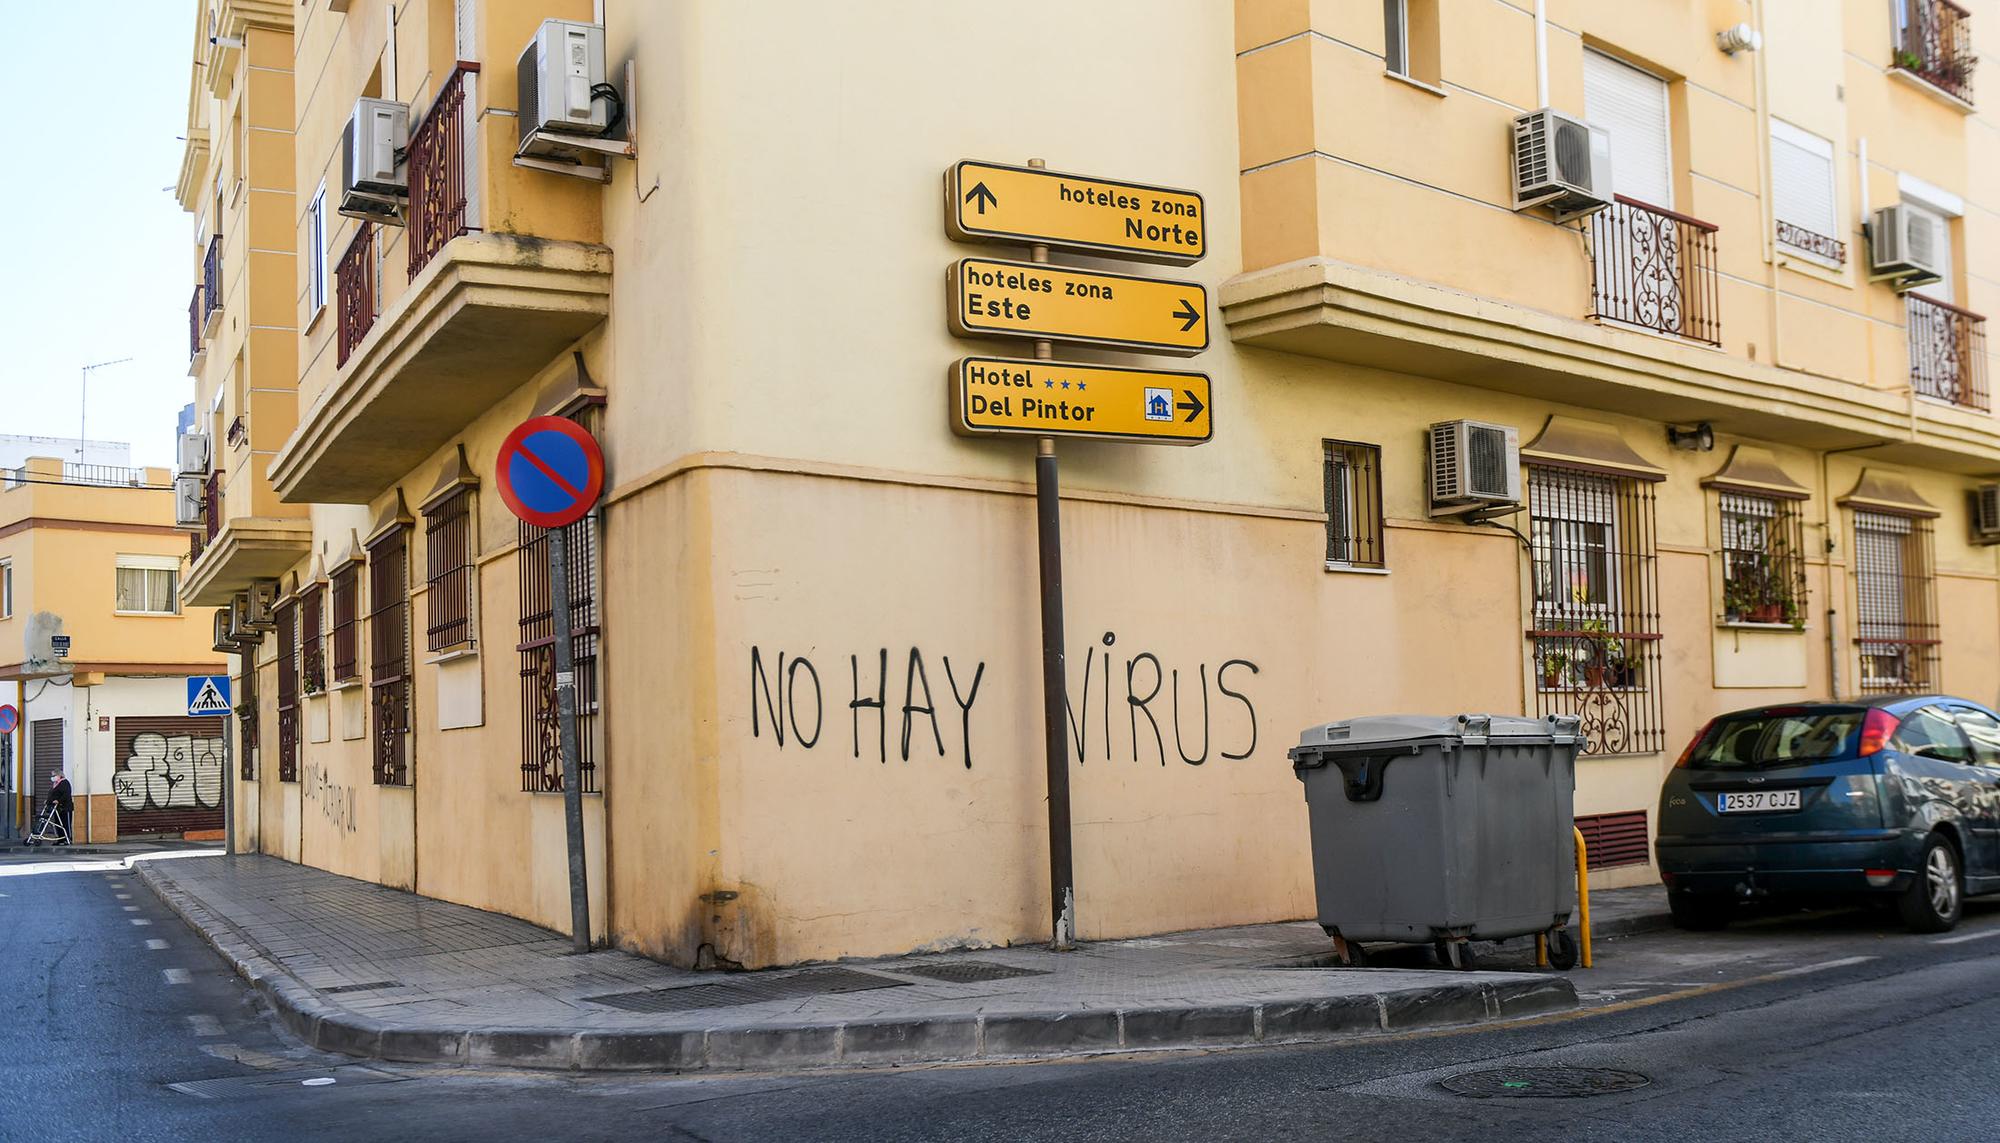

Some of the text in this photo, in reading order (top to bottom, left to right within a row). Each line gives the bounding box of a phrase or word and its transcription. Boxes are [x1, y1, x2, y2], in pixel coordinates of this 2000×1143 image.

[1060, 184, 1198, 218] hoteles zona
[1125, 217, 1199, 246] Norte
[967, 266, 1114, 300] hoteles zona
[968, 294, 1032, 321] Este
[970, 366, 1033, 388] Hotel
[971, 395, 1095, 422] Del Pintor
[751, 645, 822, 750] NO
[849, 646, 985, 770] HAY
[1727, 792, 1797, 809] 2537 CJZ
